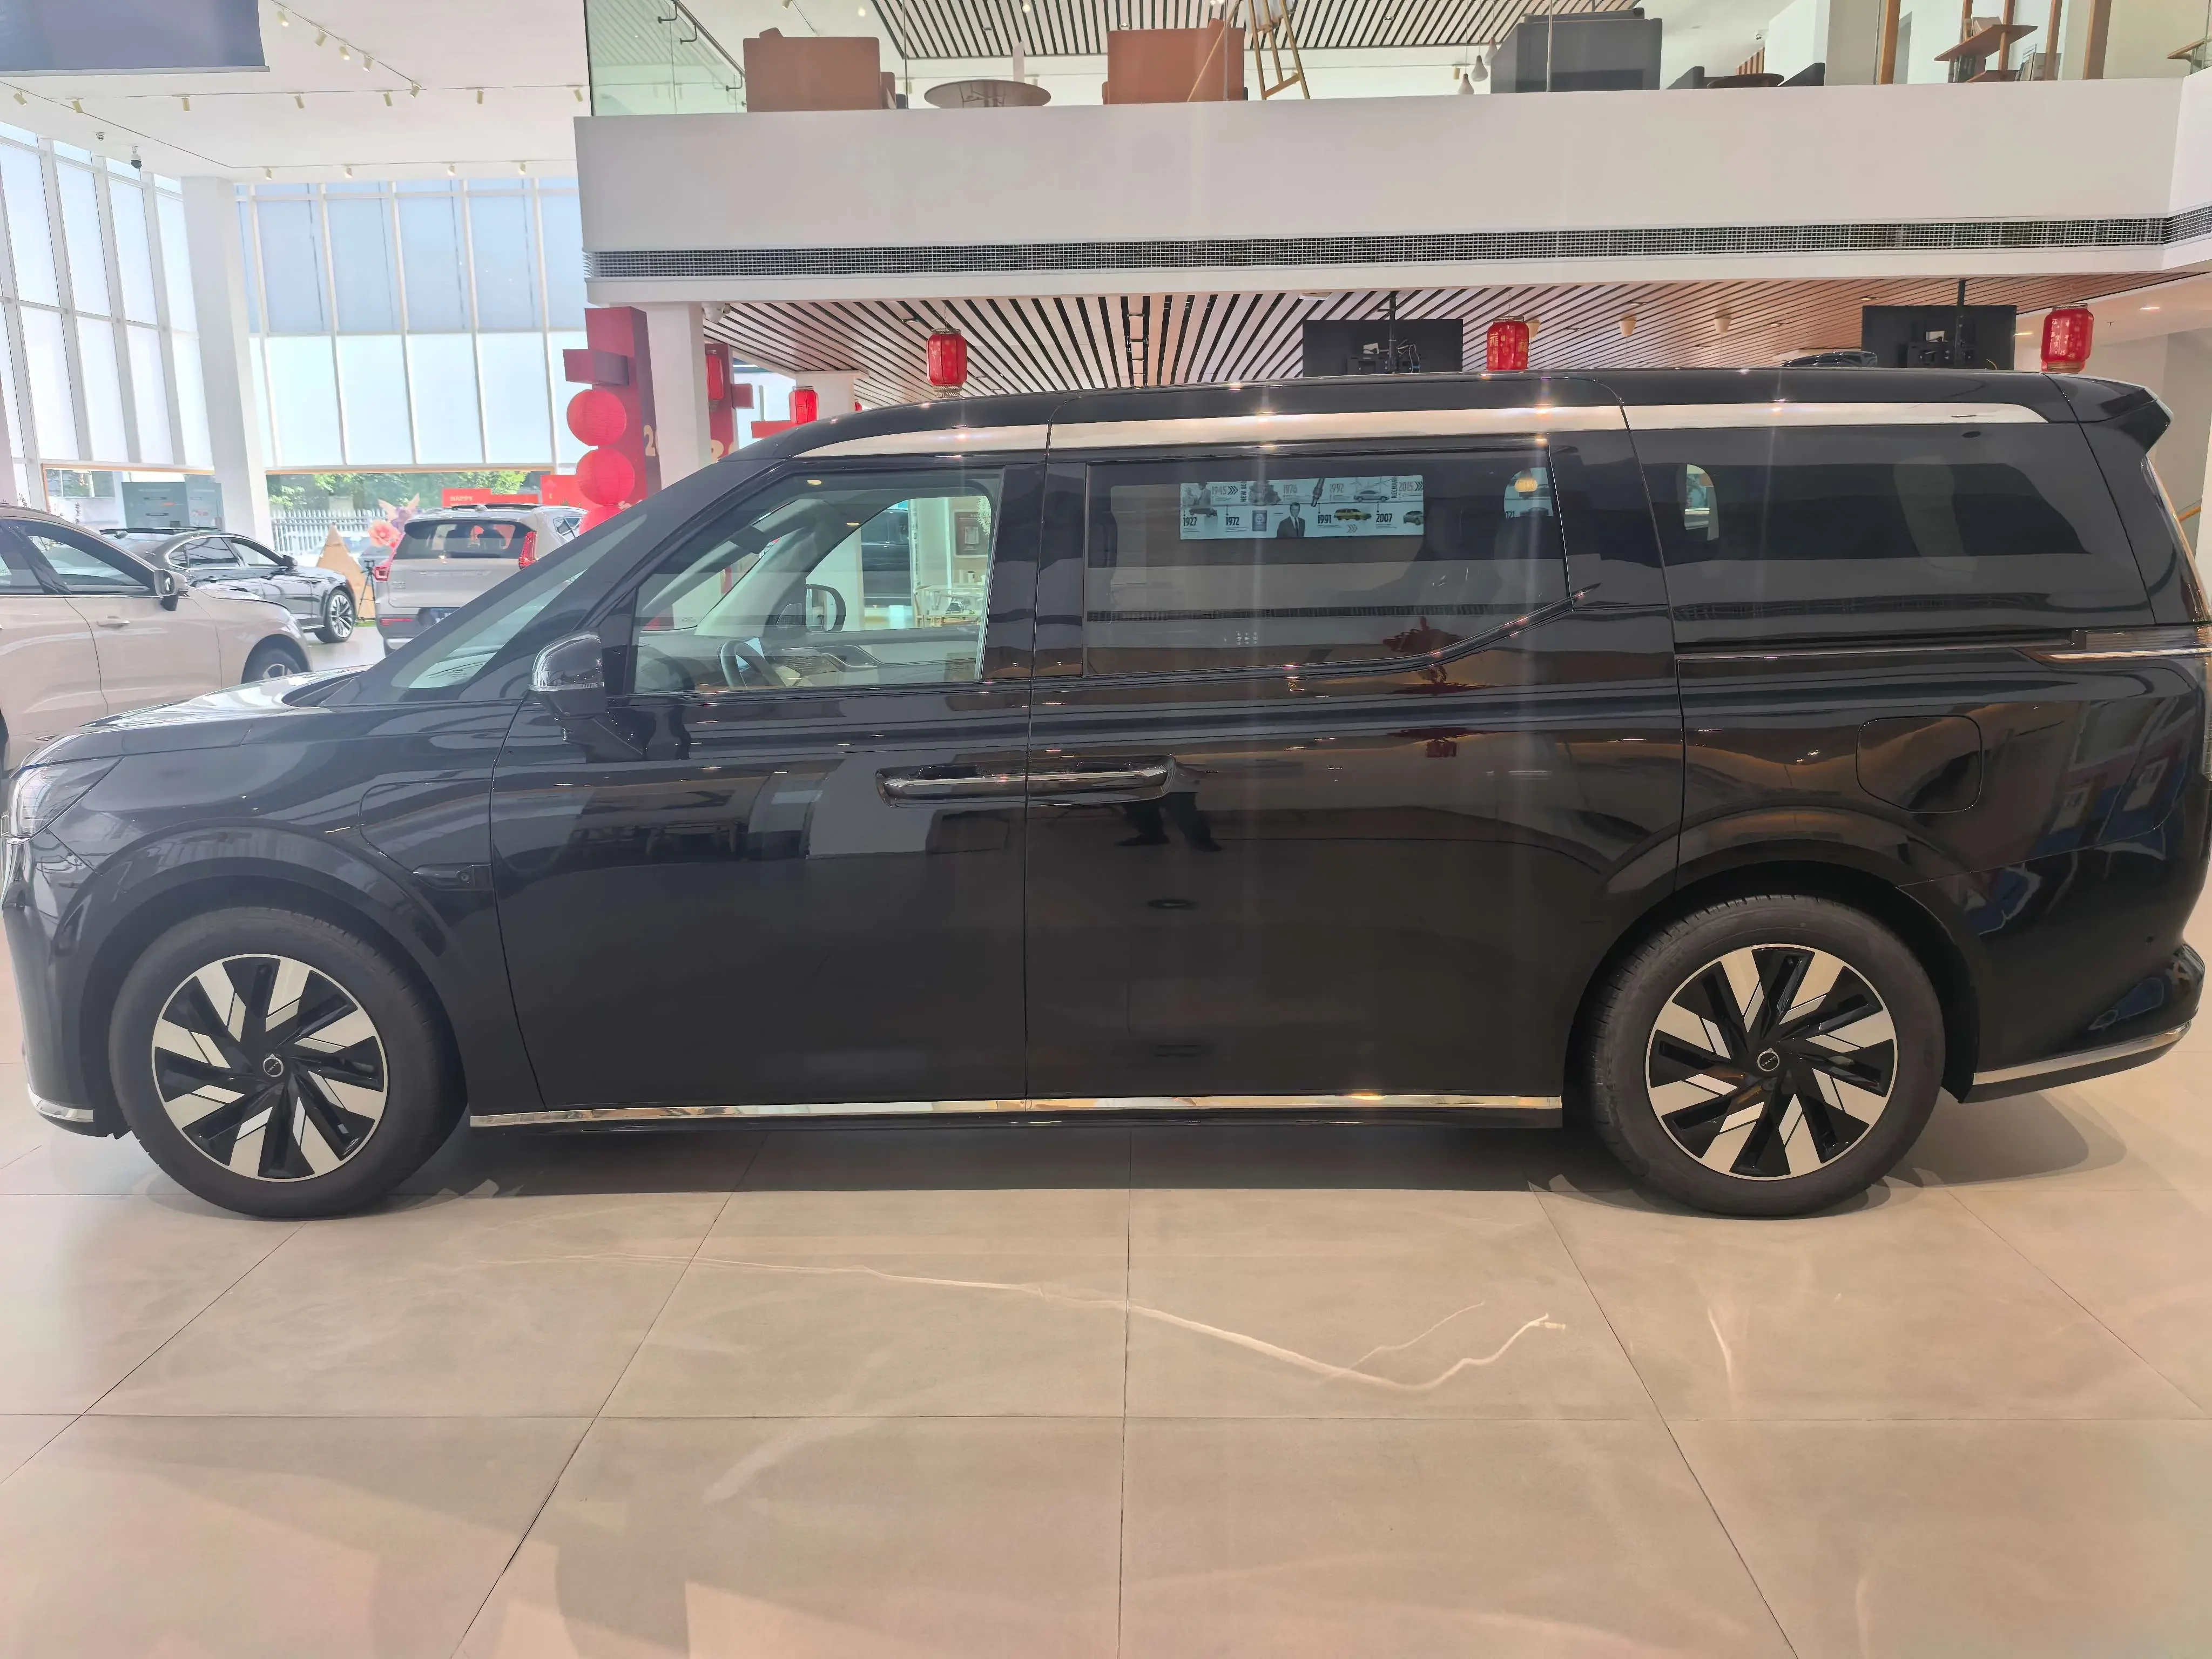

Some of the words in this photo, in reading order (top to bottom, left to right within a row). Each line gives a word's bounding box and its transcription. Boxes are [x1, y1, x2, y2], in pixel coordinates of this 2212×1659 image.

[1330, 483, 1344, 493] 1992
[1183, 517, 1197, 526] 1927
[1226, 517, 1239, 526] 1972
[1318, 515, 1332, 524] 1991
[1375, 513, 1393, 523] 2007
